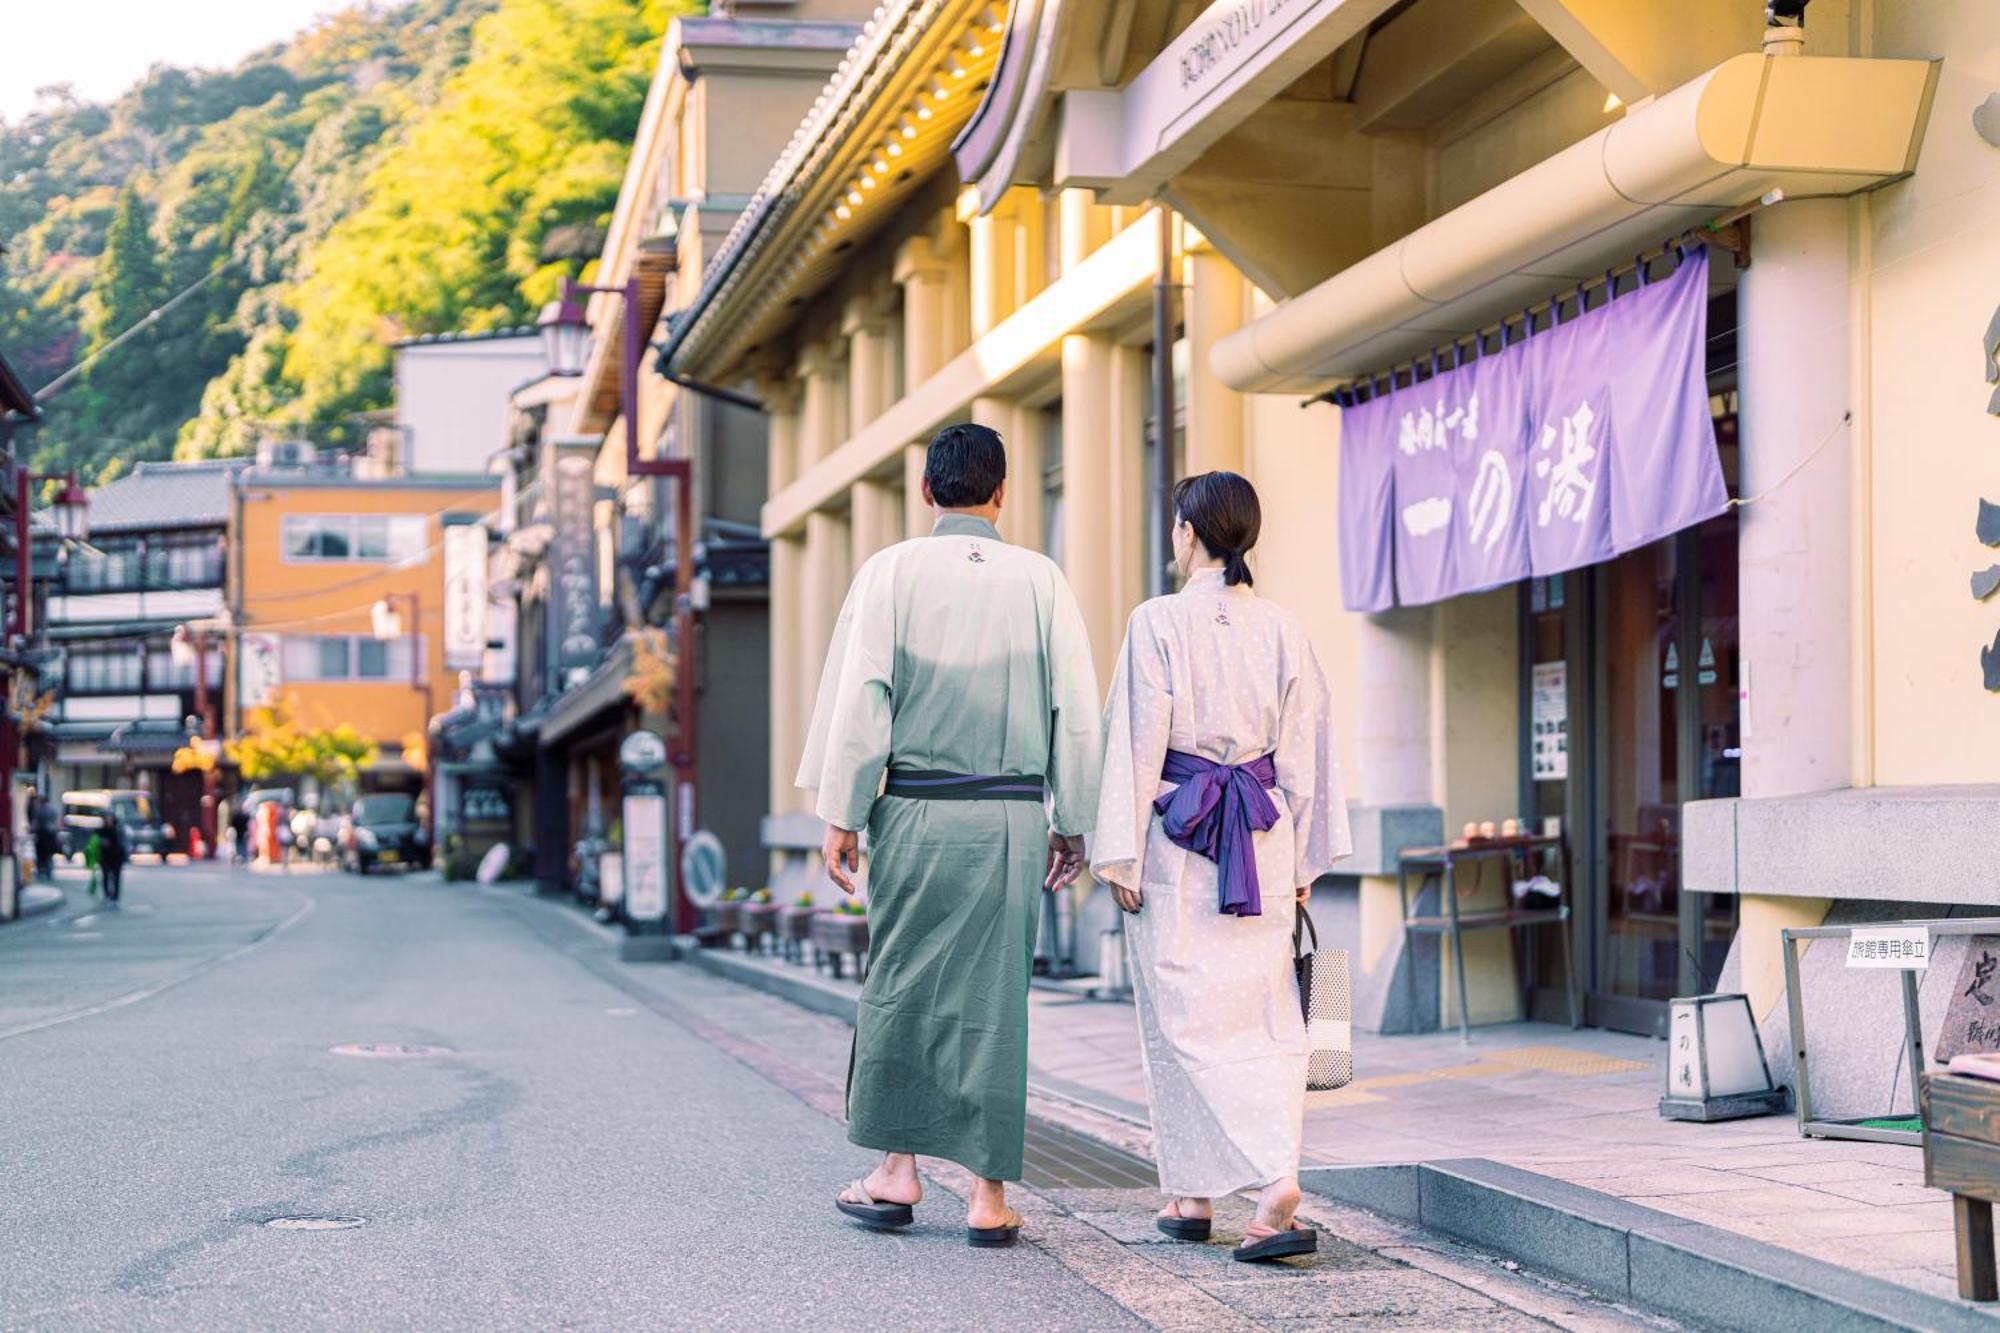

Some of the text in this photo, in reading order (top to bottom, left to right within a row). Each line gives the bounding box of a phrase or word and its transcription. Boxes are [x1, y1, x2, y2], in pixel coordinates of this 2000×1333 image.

[1402, 400, 1598, 553] 一の湯
[1851, 939, 1926, 960] 旅館専用傘立
